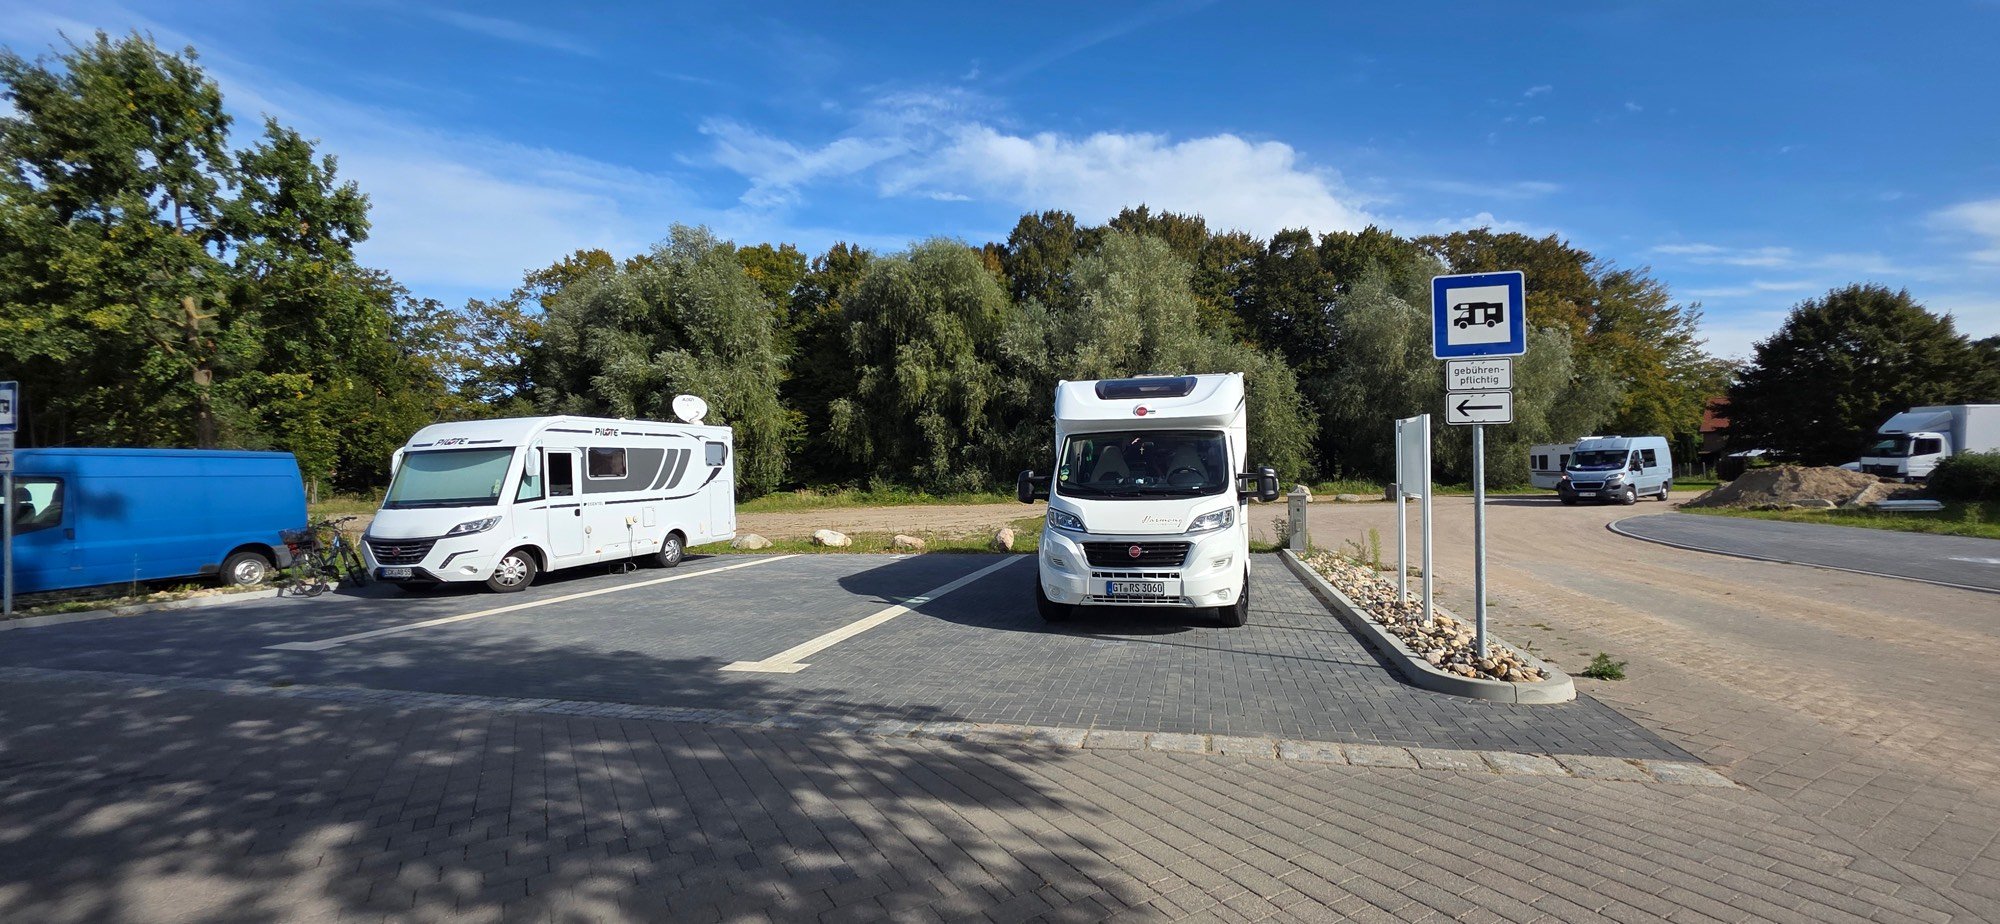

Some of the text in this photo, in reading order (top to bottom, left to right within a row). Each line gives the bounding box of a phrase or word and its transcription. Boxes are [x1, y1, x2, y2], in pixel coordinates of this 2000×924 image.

[1454, 366, 1504, 377] gebühren-
[1460, 375, 1499, 386] pflichtig
[1141, 515, 1182, 528] Harmony
[1113, 583, 1163, 593] GT RS 3060
